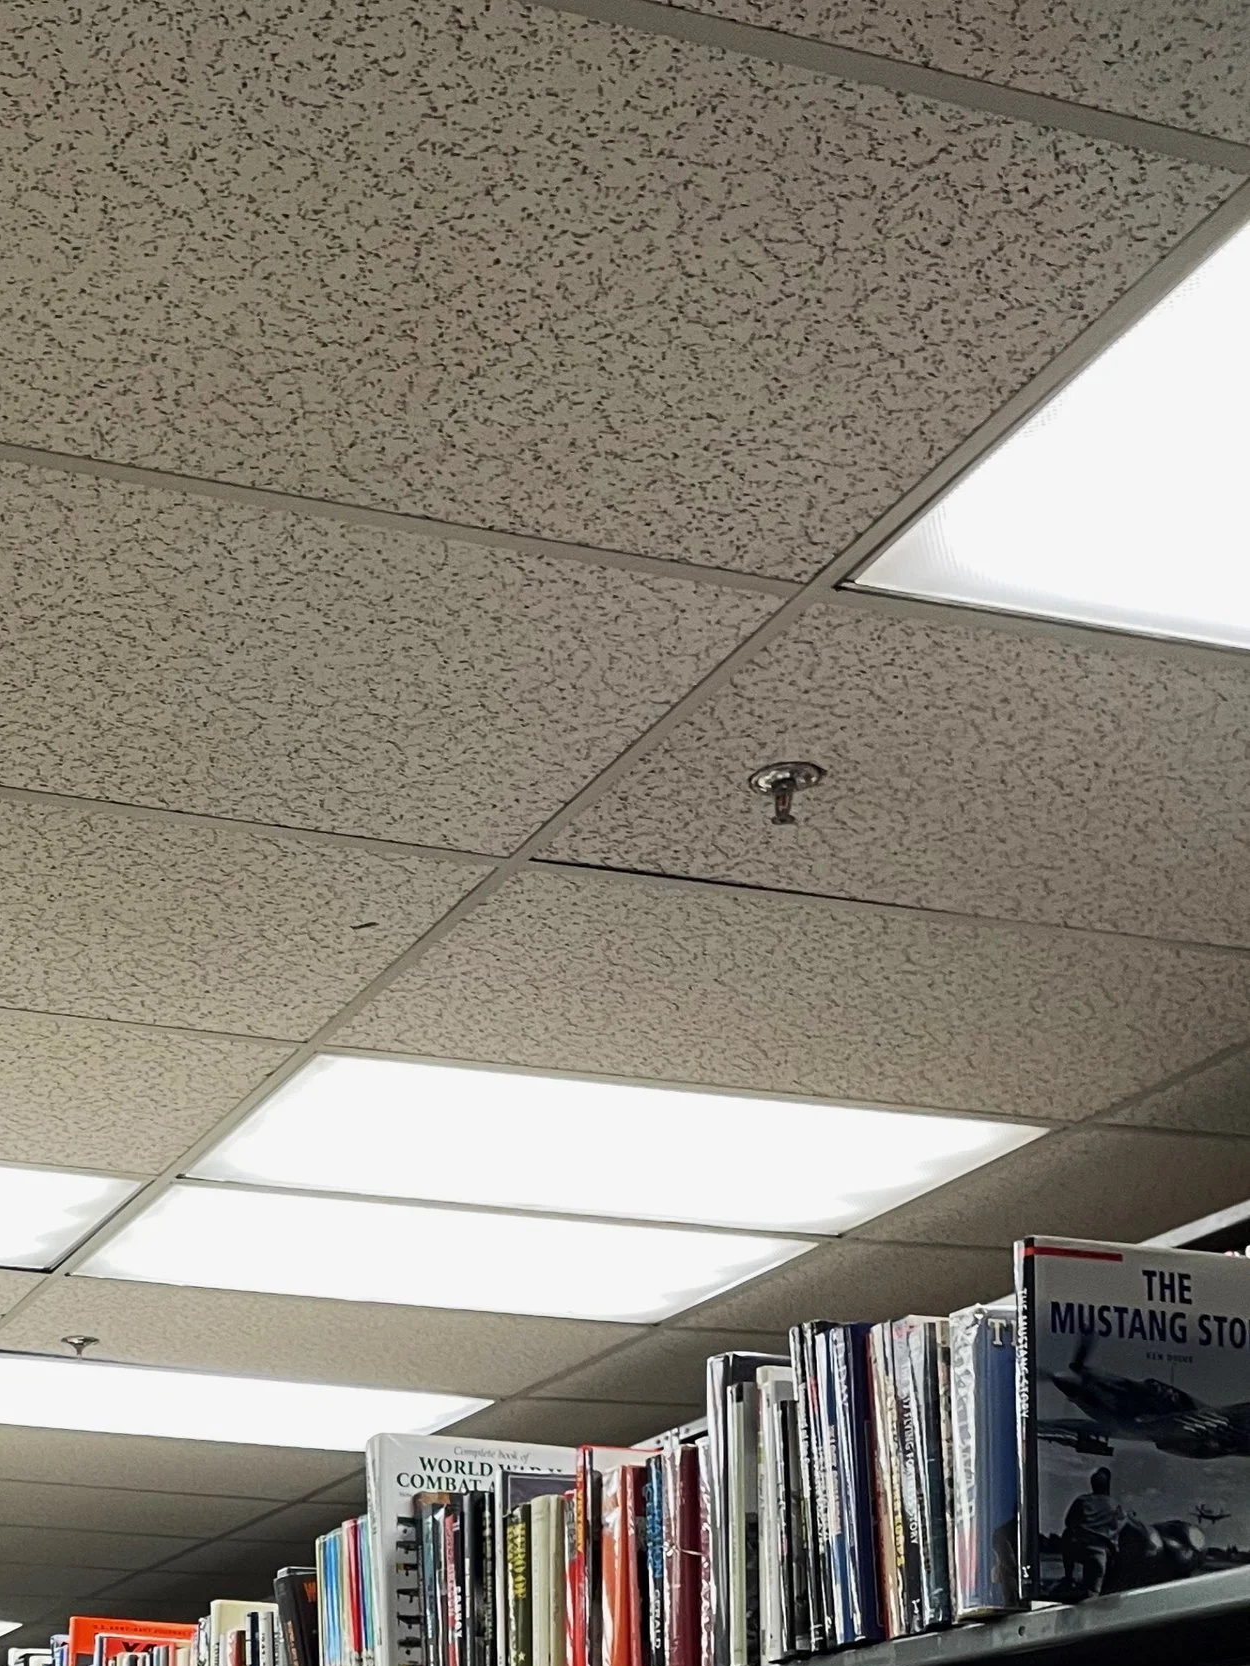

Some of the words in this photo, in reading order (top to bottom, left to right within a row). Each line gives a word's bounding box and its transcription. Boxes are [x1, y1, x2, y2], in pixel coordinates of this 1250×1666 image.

[1142, 1270, 1192, 1304] THE
[1051, 1302, 1187, 1343] MUSTANG
[1198, 1314, 1250, 1349] STO
[419, 1457, 493, 1477] WORLD
[397, 1473, 482, 1493] COMBAT
